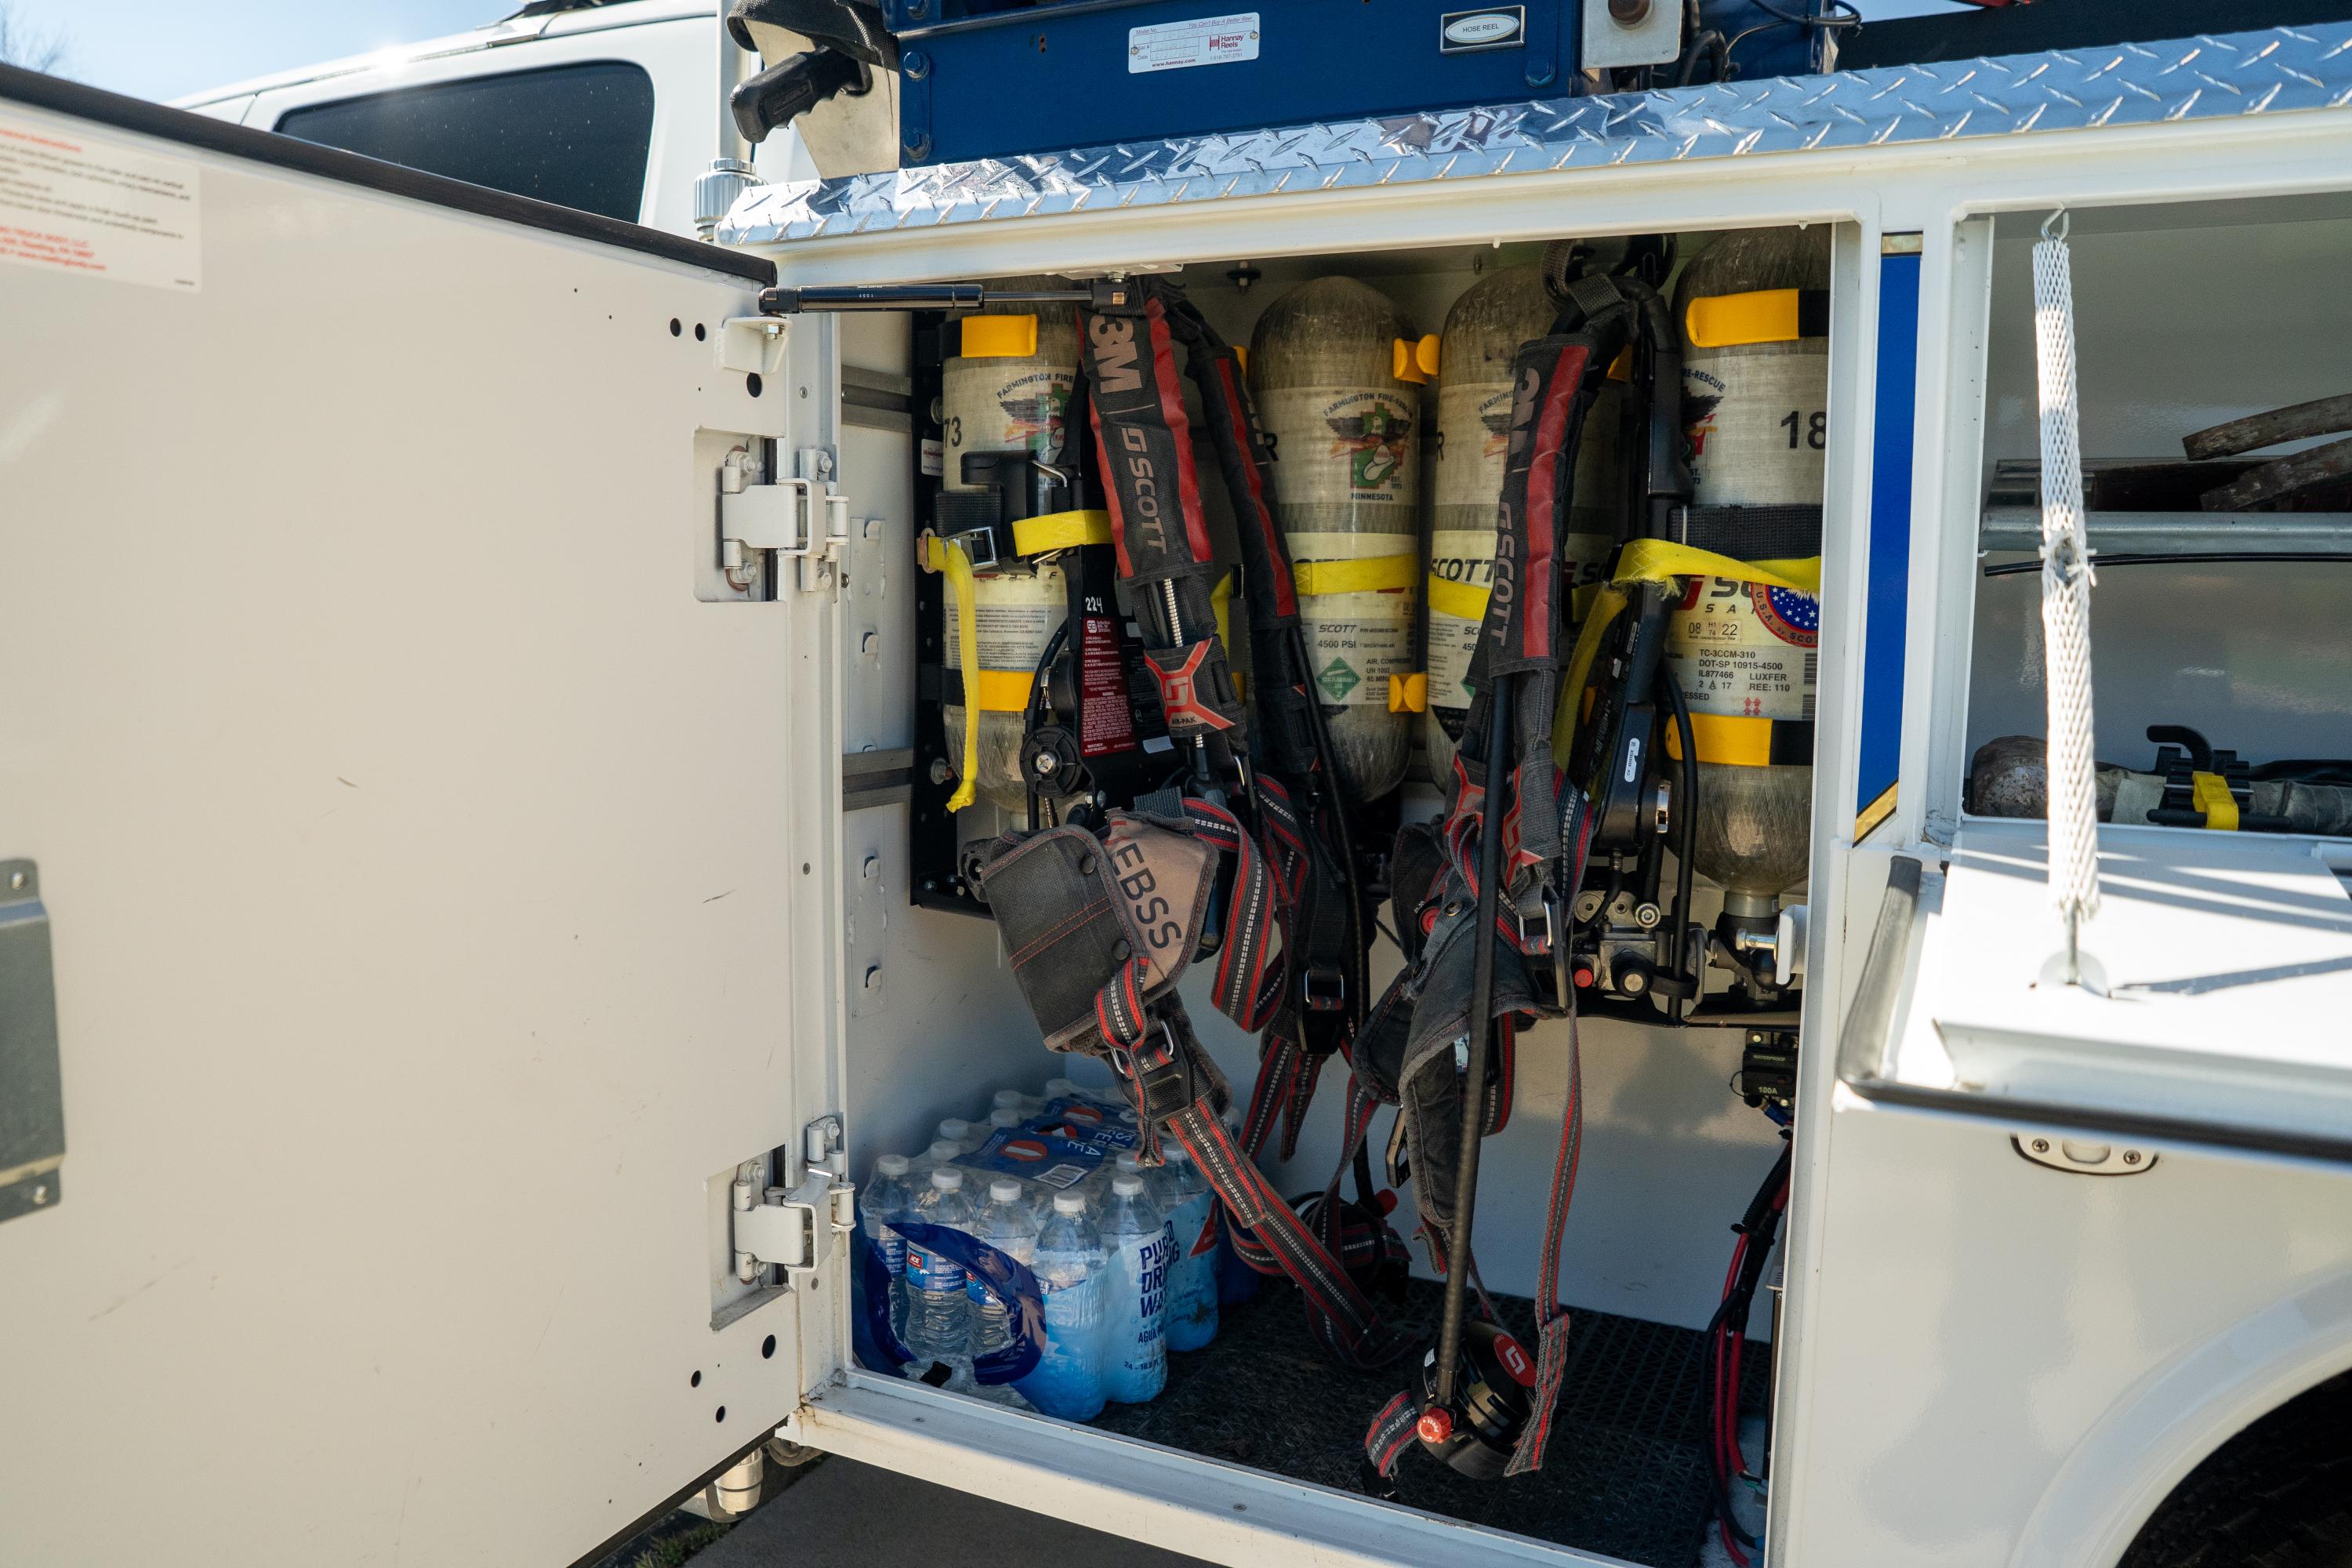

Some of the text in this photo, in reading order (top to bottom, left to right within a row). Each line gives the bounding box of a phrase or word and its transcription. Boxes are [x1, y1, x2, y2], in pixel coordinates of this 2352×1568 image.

[1152, 58, 1196, 67] www.hannay.com
[1089, 315, 1142, 394] 3M
[996, 373, 1051, 400] FARMINGTON
[1323, 393, 1374, 416] FARMINGTON
[1780, 411, 1826, 450] 18
[1351, 492, 1394, 501] MINNESOTA
[1129, 457, 1167, 554] SCOTT
[1490, 534, 1515, 647] SCOTT
[1085, 596, 1103, 614] 224
[1319, 624, 1357, 633] SCOTT
[1689, 622, 1701, 634] 08
[1722, 624, 1737, 636] 22
[1318, 640, 1339, 648] 4500
[1700, 649, 1755, 659] TC-3CCM-310
[1699, 659, 1783, 670] DOT-SP 10915-4500
[1698, 670, 1787, 681] IL877466 LUXFER
[1684, 691, 1710, 701] ESSED
[1110, 843, 1182, 949] EBSS
[1138, 1329, 1157, 1344] AGUA
[1124, 1361, 1132, 1370] 24
